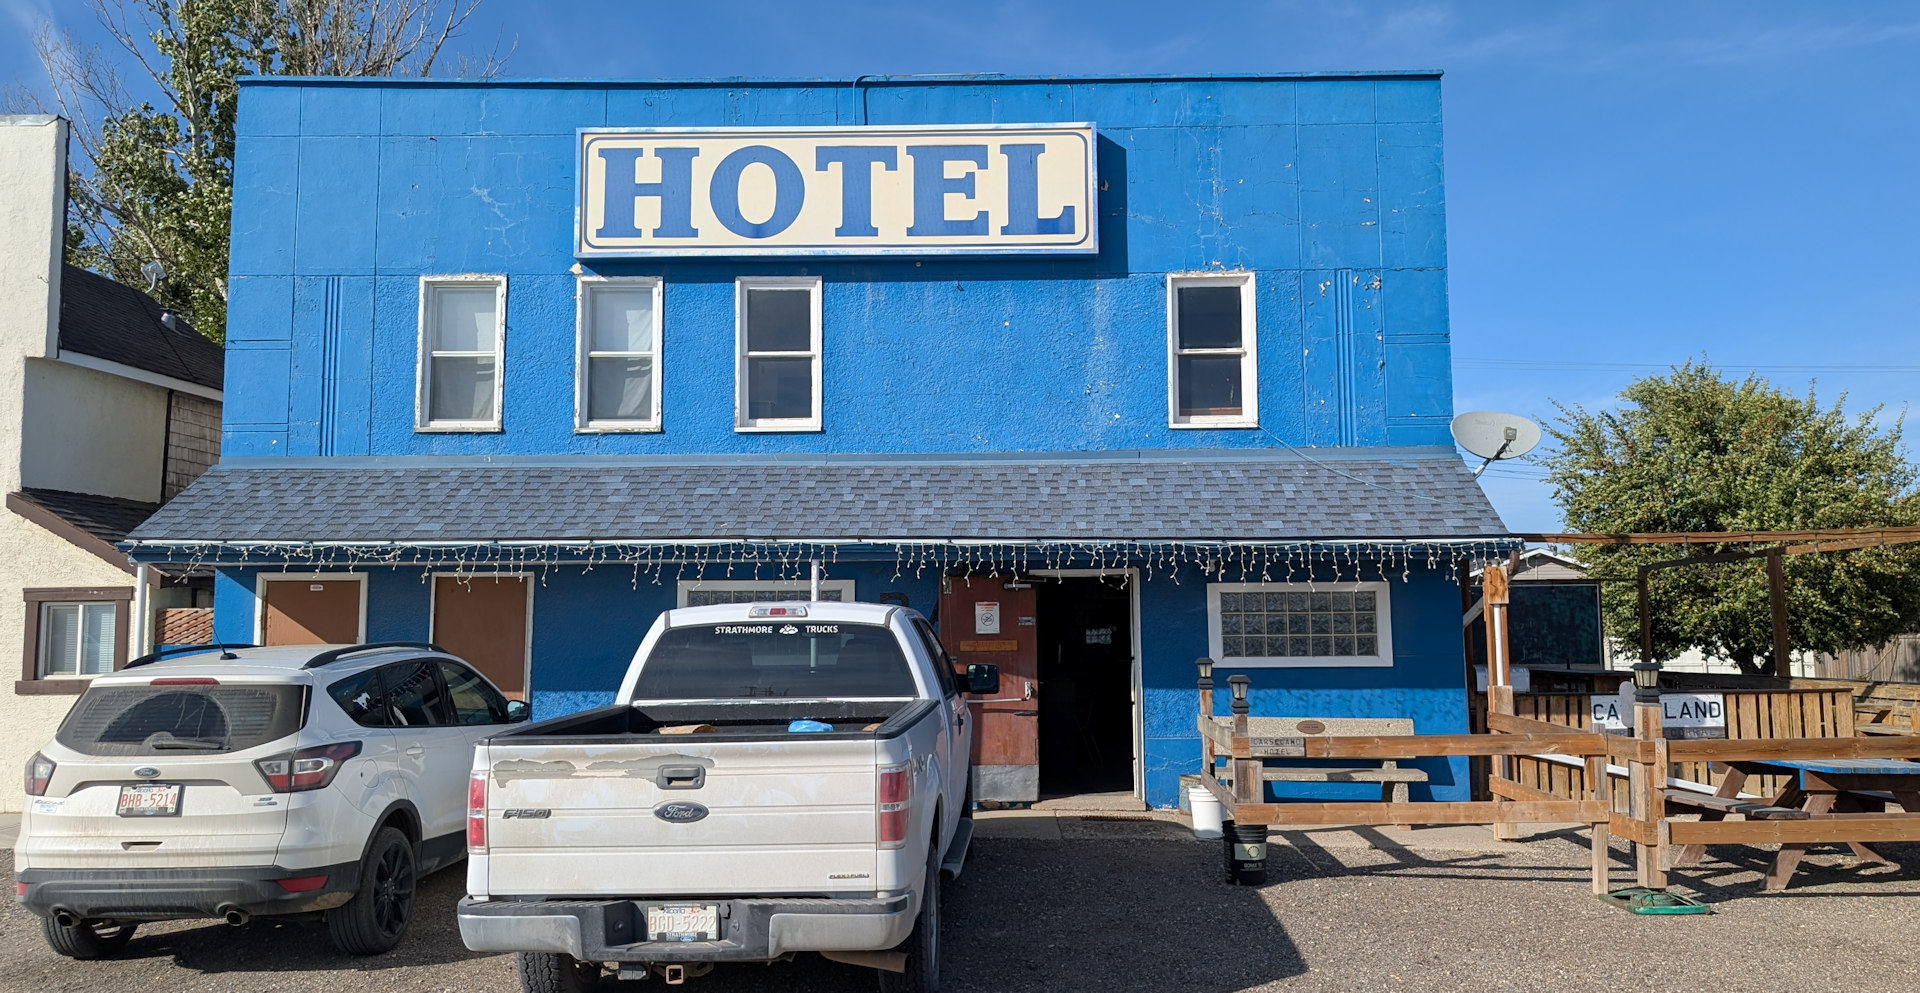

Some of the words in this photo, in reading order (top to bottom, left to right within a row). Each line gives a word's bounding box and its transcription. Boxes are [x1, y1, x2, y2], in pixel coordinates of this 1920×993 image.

[595, 143, 1076, 239] HOTEL
[714, 625, 774, 635] STRATHMORE
[805, 625, 839, 634] TRUCKS
[1592, 701, 1721, 721] CALAND
[121, 793, 177, 808] BHB-5214
